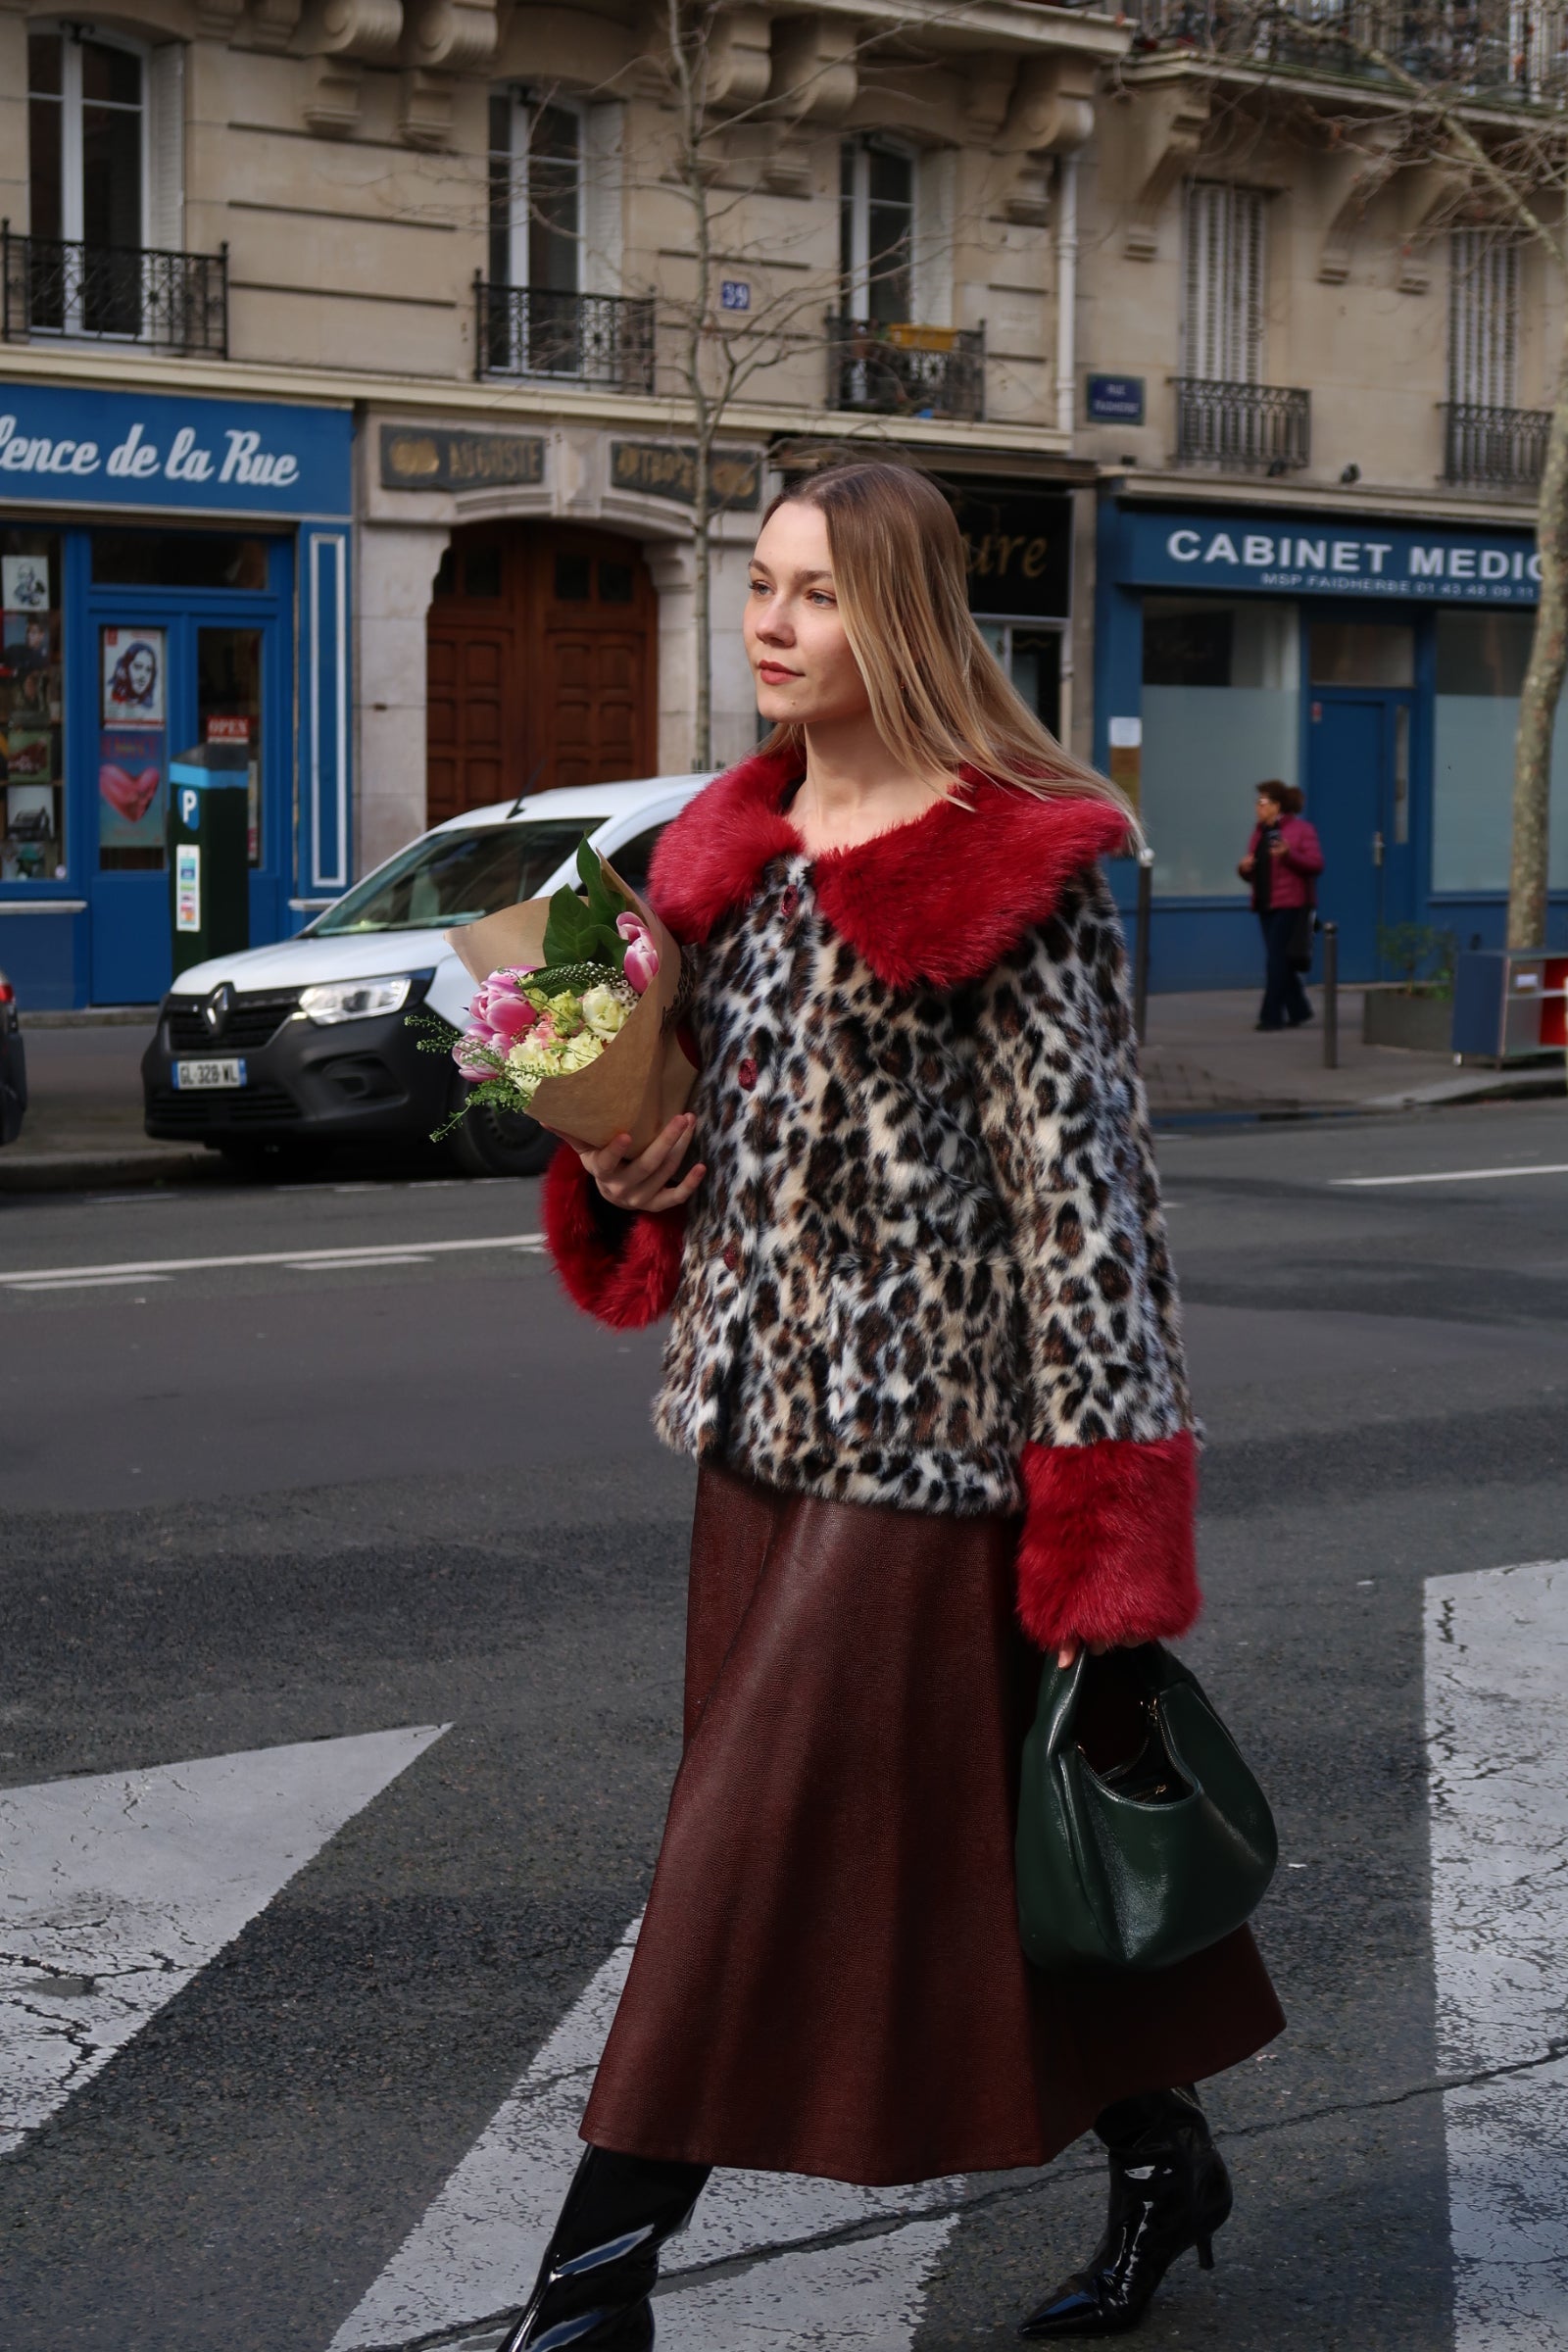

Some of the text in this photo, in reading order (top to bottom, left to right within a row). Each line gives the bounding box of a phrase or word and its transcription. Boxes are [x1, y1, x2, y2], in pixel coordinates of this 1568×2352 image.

[106, 422, 161, 478] de
[164, 425, 216, 482] la
[218, 428, 301, 487] Rue
[1166, 528, 1393, 574] CABINET
[1260, 572, 1302, 586] MSP
[1306, 574, 1411, 593] FAIDHERBE
[1415, 581, 1435, 595] 01
[1441, 583, 1462, 596] 43
[208, 718, 248, 735] OPEN
[182, 789, 198, 824] P
